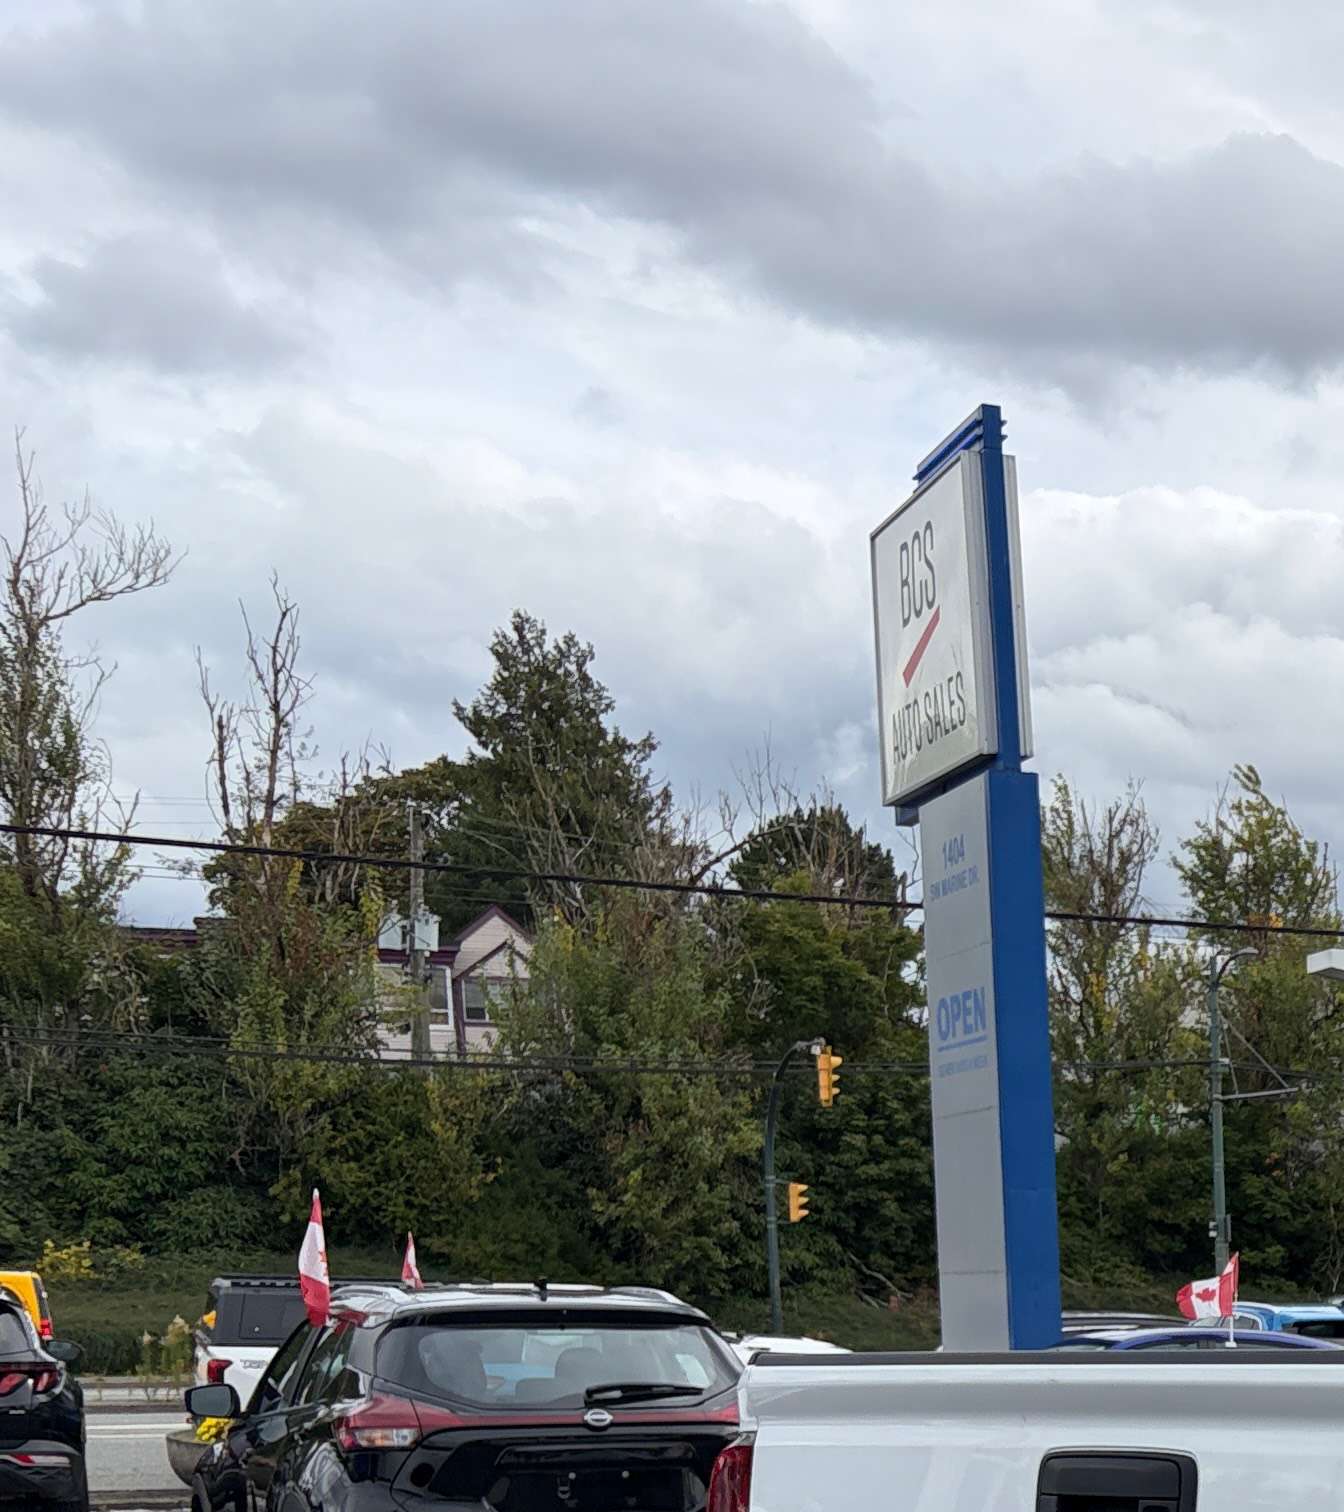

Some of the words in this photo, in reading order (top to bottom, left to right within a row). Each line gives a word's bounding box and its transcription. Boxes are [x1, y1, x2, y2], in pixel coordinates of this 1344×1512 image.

[900, 521, 936, 628] BCS
[892, 698, 923, 764] AUTO
[923, 672, 966, 743] SALES
[942, 835, 966, 869] 1404
[938, 987, 986, 1041] OPEN
